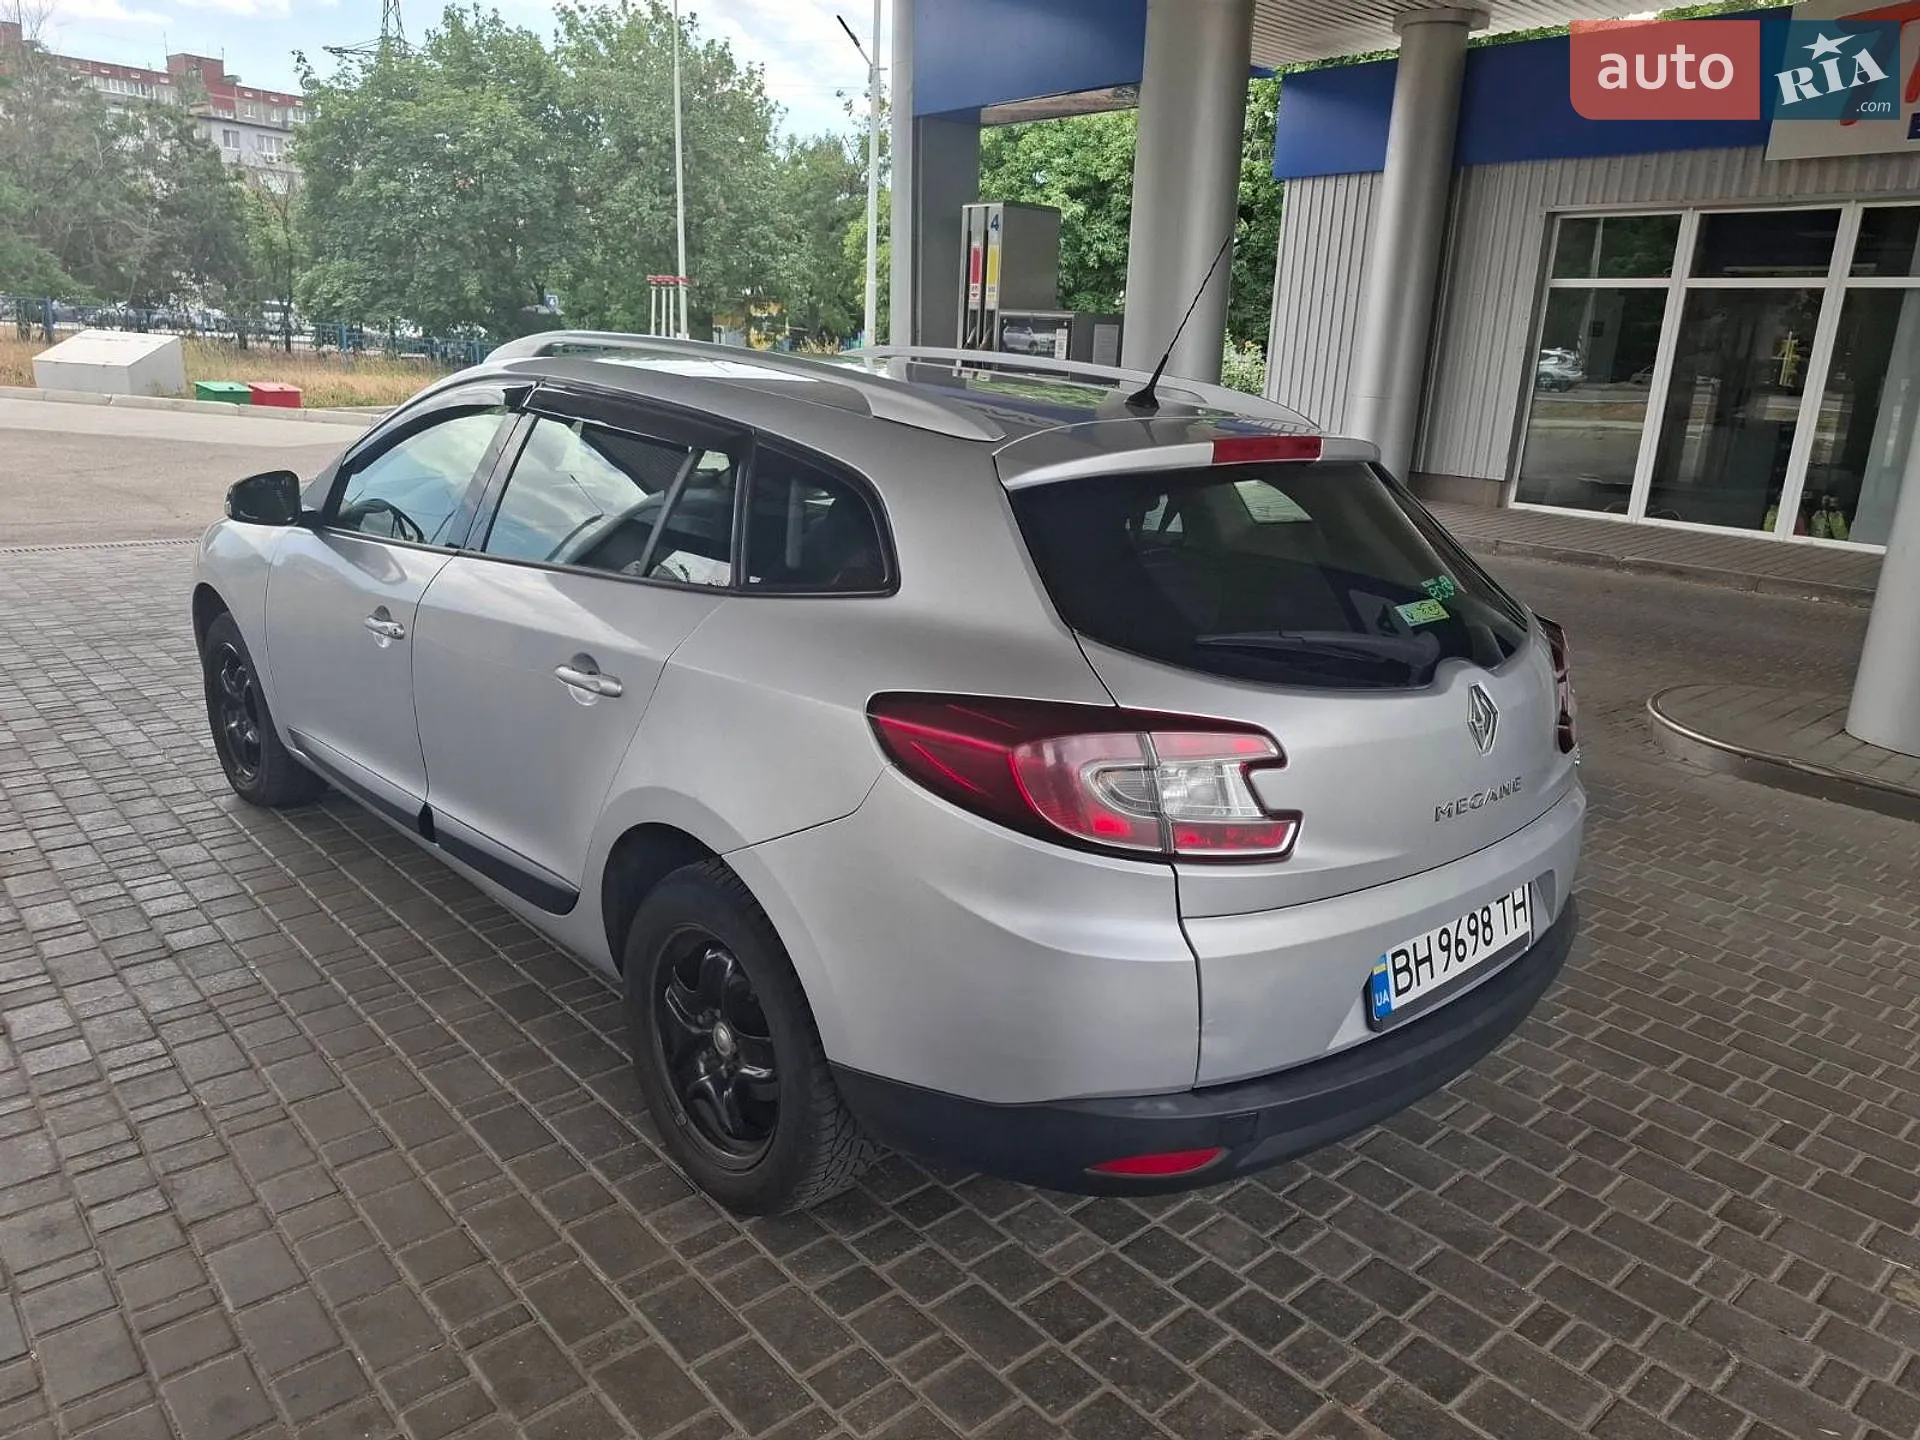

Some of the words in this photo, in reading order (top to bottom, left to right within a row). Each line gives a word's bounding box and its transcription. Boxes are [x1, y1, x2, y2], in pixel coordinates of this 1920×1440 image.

[990, 213, 1000, 232] 4
[1434, 776, 1522, 822] MEGANE
[1391, 935, 1434, 998] BH
[1438, 906, 1493, 972] 9698
[1496, 885, 1528, 936] TH
[1376, 994, 1390, 1006] UA
